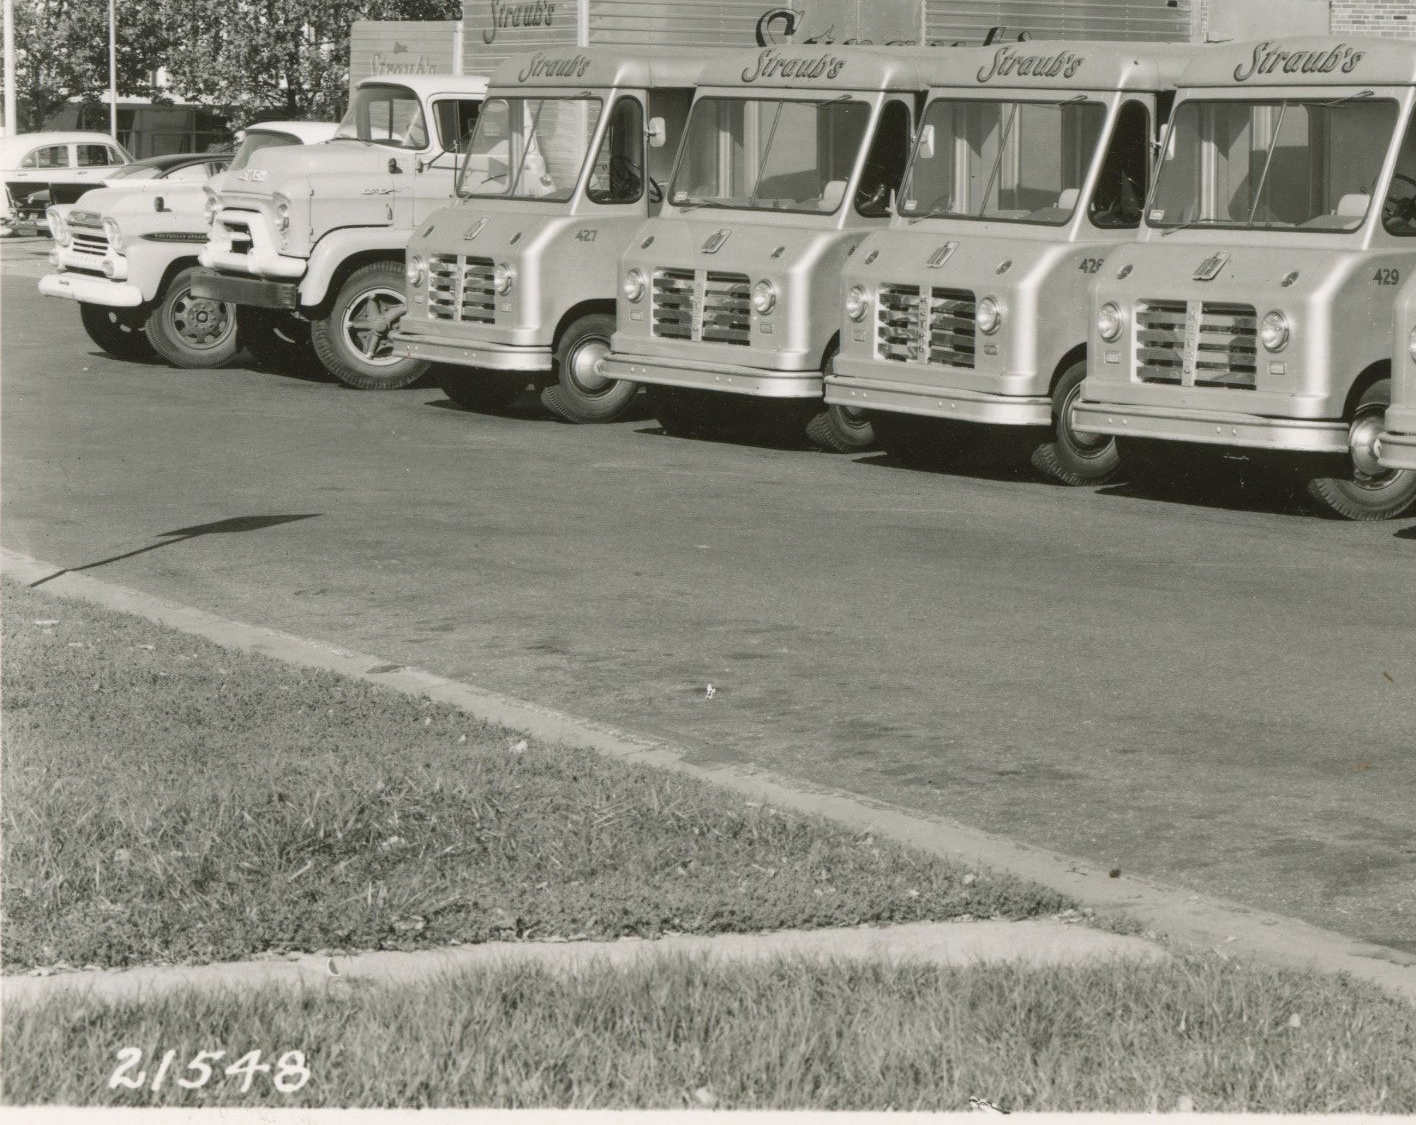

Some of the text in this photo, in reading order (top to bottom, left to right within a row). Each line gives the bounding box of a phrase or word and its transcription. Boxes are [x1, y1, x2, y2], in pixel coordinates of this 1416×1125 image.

[518, 50, 592, 83] Straub's
[741, 48, 847, 83] Straub's
[976, 46, 1084, 83] Straub's
[1233, 42, 1367, 81] Straub's
[574, 229, 598, 242] 427
[1373, 268, 1400, 285] 429
